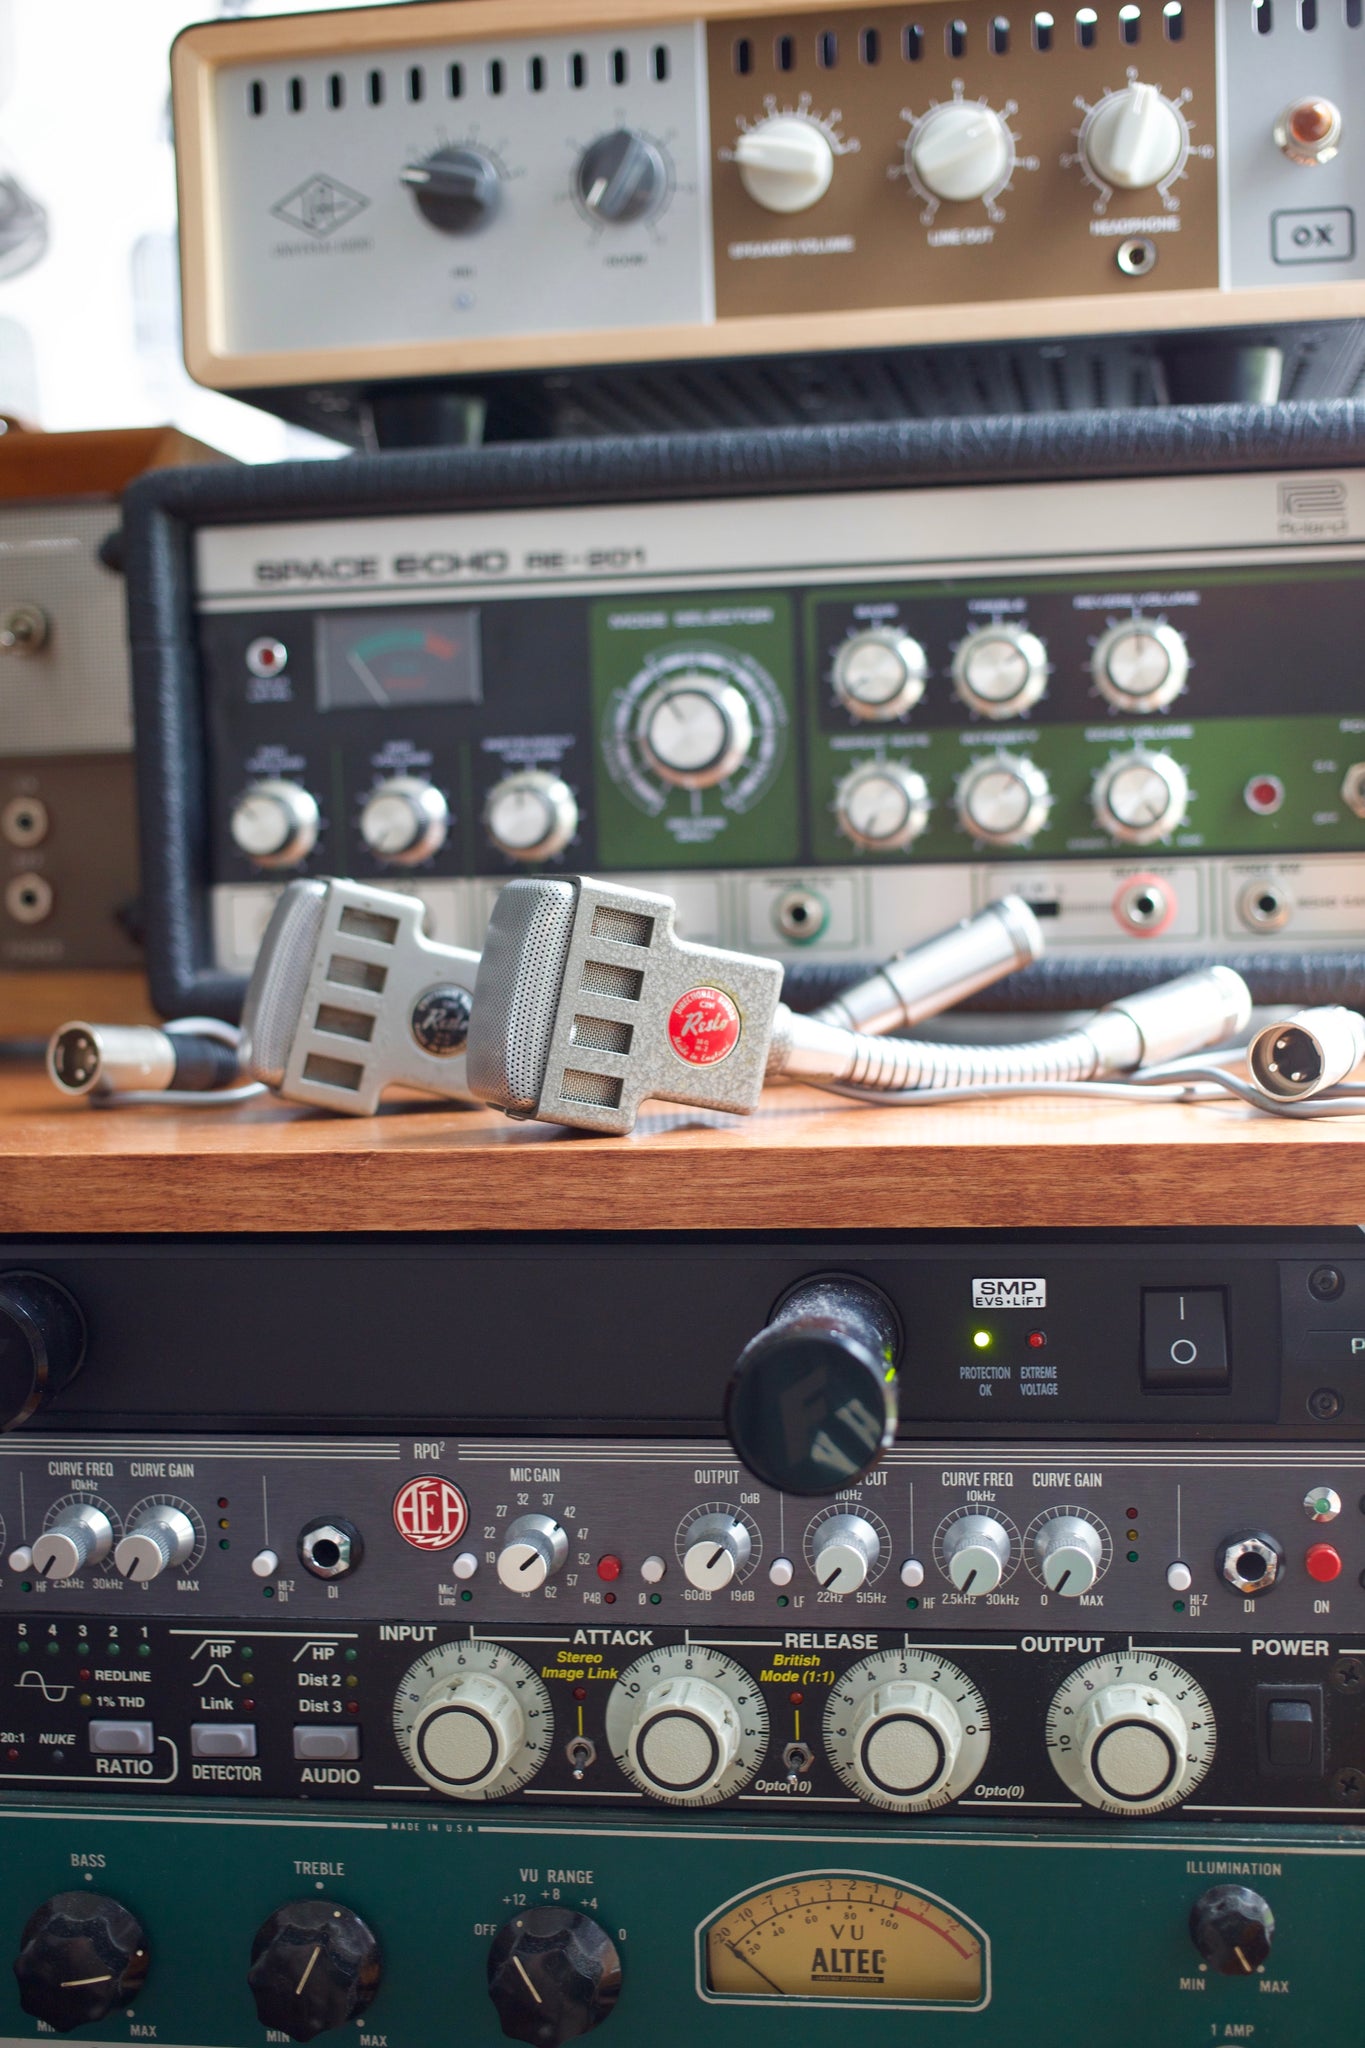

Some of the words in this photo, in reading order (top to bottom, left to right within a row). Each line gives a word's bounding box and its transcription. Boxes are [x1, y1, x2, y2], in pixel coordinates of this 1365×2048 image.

[1090, 215, 1181, 235] HEADPHONE
[1292, 224, 1335, 246] OX
[255, 557, 379, 584] SPACE
[392, 549, 508, 576] ECHO
[981, 1281, 1036, 1295] SMP
[960, 1366, 1011, 1379] PROTECTION
[1021, 1366, 1058, 1379] EXTREME
[979, 1384, 992, 1396] OK
[1020, 1383, 1058, 1396] VOLTAGE
[48, 1461, 83, 1477] CURVE
[86, 1462, 114, 1477] FREQ
[130, 1463, 166, 1478] CURVE
[168, 1463, 194, 1478] GAIN
[510, 1468, 532, 1482] MIC
[533, 1468, 560, 1482] GAIN
[695, 1470, 740, 1484] OUTPUT
[865, 1471, 888, 1486] CUT
[942, 1472, 980, 1487] CURVE
[983, 1472, 1014, 1487] FREQ
[1033, 1473, 1070, 1487] CURVE
[1074, 1473, 1102, 1487] GAIN
[71, 1480, 98, 1491] 10kHz
[517, 1493, 528, 1505] 32
[542, 1494, 554, 1505] 37
[740, 1493, 760, 1504] 0dB
[967, 1490, 996, 1502] 10kHz
[397, 1480, 464, 1546] AEA
[496, 1505, 507, 1517] 27
[564, 1506, 576, 1518] 42
[484, 1527, 496, 1539] 22
[577, 1528, 589, 1540] 47
[486, 1552, 496, 1563] 19
[578, 1553, 590, 1565] 52
[92, 1578, 124, 1590] 30kHz
[177, 1580, 200, 1592] MAX
[567, 1574, 578, 1586] 57
[36, 1581, 48, 1592] HF
[328, 1586, 338, 1599] DI
[545, 1586, 557, 1598] 62
[439, 1596, 457, 1606] Line
[680, 1590, 713, 1601] -60dB
[731, 1590, 755, 1602] 19dB
[817, 1592, 843, 1603] 22Hz
[856, 1592, 887, 1604] 515Hz
[986, 1594, 1020, 1606] 30kHz
[1040, 1595, 1048, 1606] 0
[1080, 1595, 1104, 1606] MAX
[1190, 1594, 1208, 1606] HI-Z
[794, 1596, 805, 1608] LF
[923, 1598, 936, 1609] HF
[1244, 1600, 1255, 1613] DI
[1314, 1600, 1330, 1614] ON
[1190, 1606, 1200, 1617] DI
[18, 1624, 27, 1635] 5
[48, 1624, 57, 1636] 4
[78, 1625, 87, 1637] 3
[109, 1626, 118, 1637] 2
[141, 1626, 148, 1638] 1
[379, 1626, 437, 1641] INPUT
[573, 1630, 654, 1645] ATTACK
[785, 1633, 878, 1649] RELEASE
[1021, 1636, 1104, 1653] OUTPUT
[1252, 1639, 1329, 1656] POWER
[210, 1645, 232, 1658] HP
[312, 1648, 335, 1661] HP
[557, 1651, 603, 1664] Stereo
[685, 1659, 693, 1670] 8
[773, 1653, 821, 1667] British
[95, 1670, 152, 1682] REDLINE
[542, 1667, 585, 1681] Image
[587, 1667, 619, 1680] Link
[652, 1665, 661, 1676] 9
[715, 1669, 726, 1679] 7
[1115, 1666, 1123, 1677] 7
[1149, 1670, 1158, 1681] 6
[298, 1673, 328, 1686] Dist
[332, 1674, 342, 1687] 2
[760, 1670, 799, 1682] Mode
[802, 1670, 835, 1685] (1:1)
[624, 1682, 640, 1699] 10
[1084, 1680, 1094, 1691] 8
[738, 1696, 748, 1705] 6
[1176, 1690, 1188, 1701] 5
[96, 1696, 116, 1707] 1%
[119, 1697, 145, 1708] THD
[201, 1697, 234, 1710] Link
[299, 1699, 329, 1713] Dist
[332, 1700, 342, 1713] 3
[1063, 1706, 1074, 1715] 9
[1191, 1721, 1201, 1730] 4
[1, 1733, 25, 1743] 20:1
[745, 1728, 755, 1737] 5
[38, 1734, 76, 1745] NUKE
[1060, 1735, 1072, 1752] 10
[735, 1758, 744, 1768] 4
[1187, 1754, 1198, 1764] 3
[96, 1758, 153, 1775] RATIO
[192, 1765, 262, 1781] DETECTOR
[301, 1768, 361, 1784] AUDIO
[754, 1779, 812, 1794] Opto(10)
[974, 1784, 1025, 1798] Opto(0)
[391, 1822, 420, 1832] MADE
[427, 1823, 439, 1832] IN
[71, 1853, 106, 1868] BASS
[293, 1861, 345, 1877] TREBLE
[1186, 1861, 1282, 1876] ILLUMINATION
[519, 1868, 539, 1883] VU
[547, 1869, 594, 1884] RANGE
[819, 1880, 833, 1891] -3
[841, 1880, 857, 1890] -2
[865, 1884, 879, 1893] -1
[785, 1886, 800, 1897] -5
[894, 1890, 903, 1900] 0
[502, 1893, 527, 1906] +12
[580, 1897, 598, 1910] +4
[761, 1895, 773, 1906] -7
[734, 1907, 753, 1924] -10
[805, 1915, 818, 1925] 60
[844, 1912, 857, 1920] 80
[474, 1923, 497, 1936] OFF
[880, 1918, 899, 1930] 100
[618, 1929, 627, 1940] 0
[773, 1926, 785, 1937] 40
[748, 1943, 761, 1955] 20
[811, 1947, 885, 1974] ALTEC
[1180, 1978, 1206, 1990] MIN
[1260, 1980, 1289, 1993] MAX
[130, 2025, 157, 2038] MAX
[1211, 2023, 1217, 2035] 1
[1224, 2025, 1254, 2037] AMP
[266, 2030, 291, 2043] MIN
[360, 2035, 387, 2047] MAX
